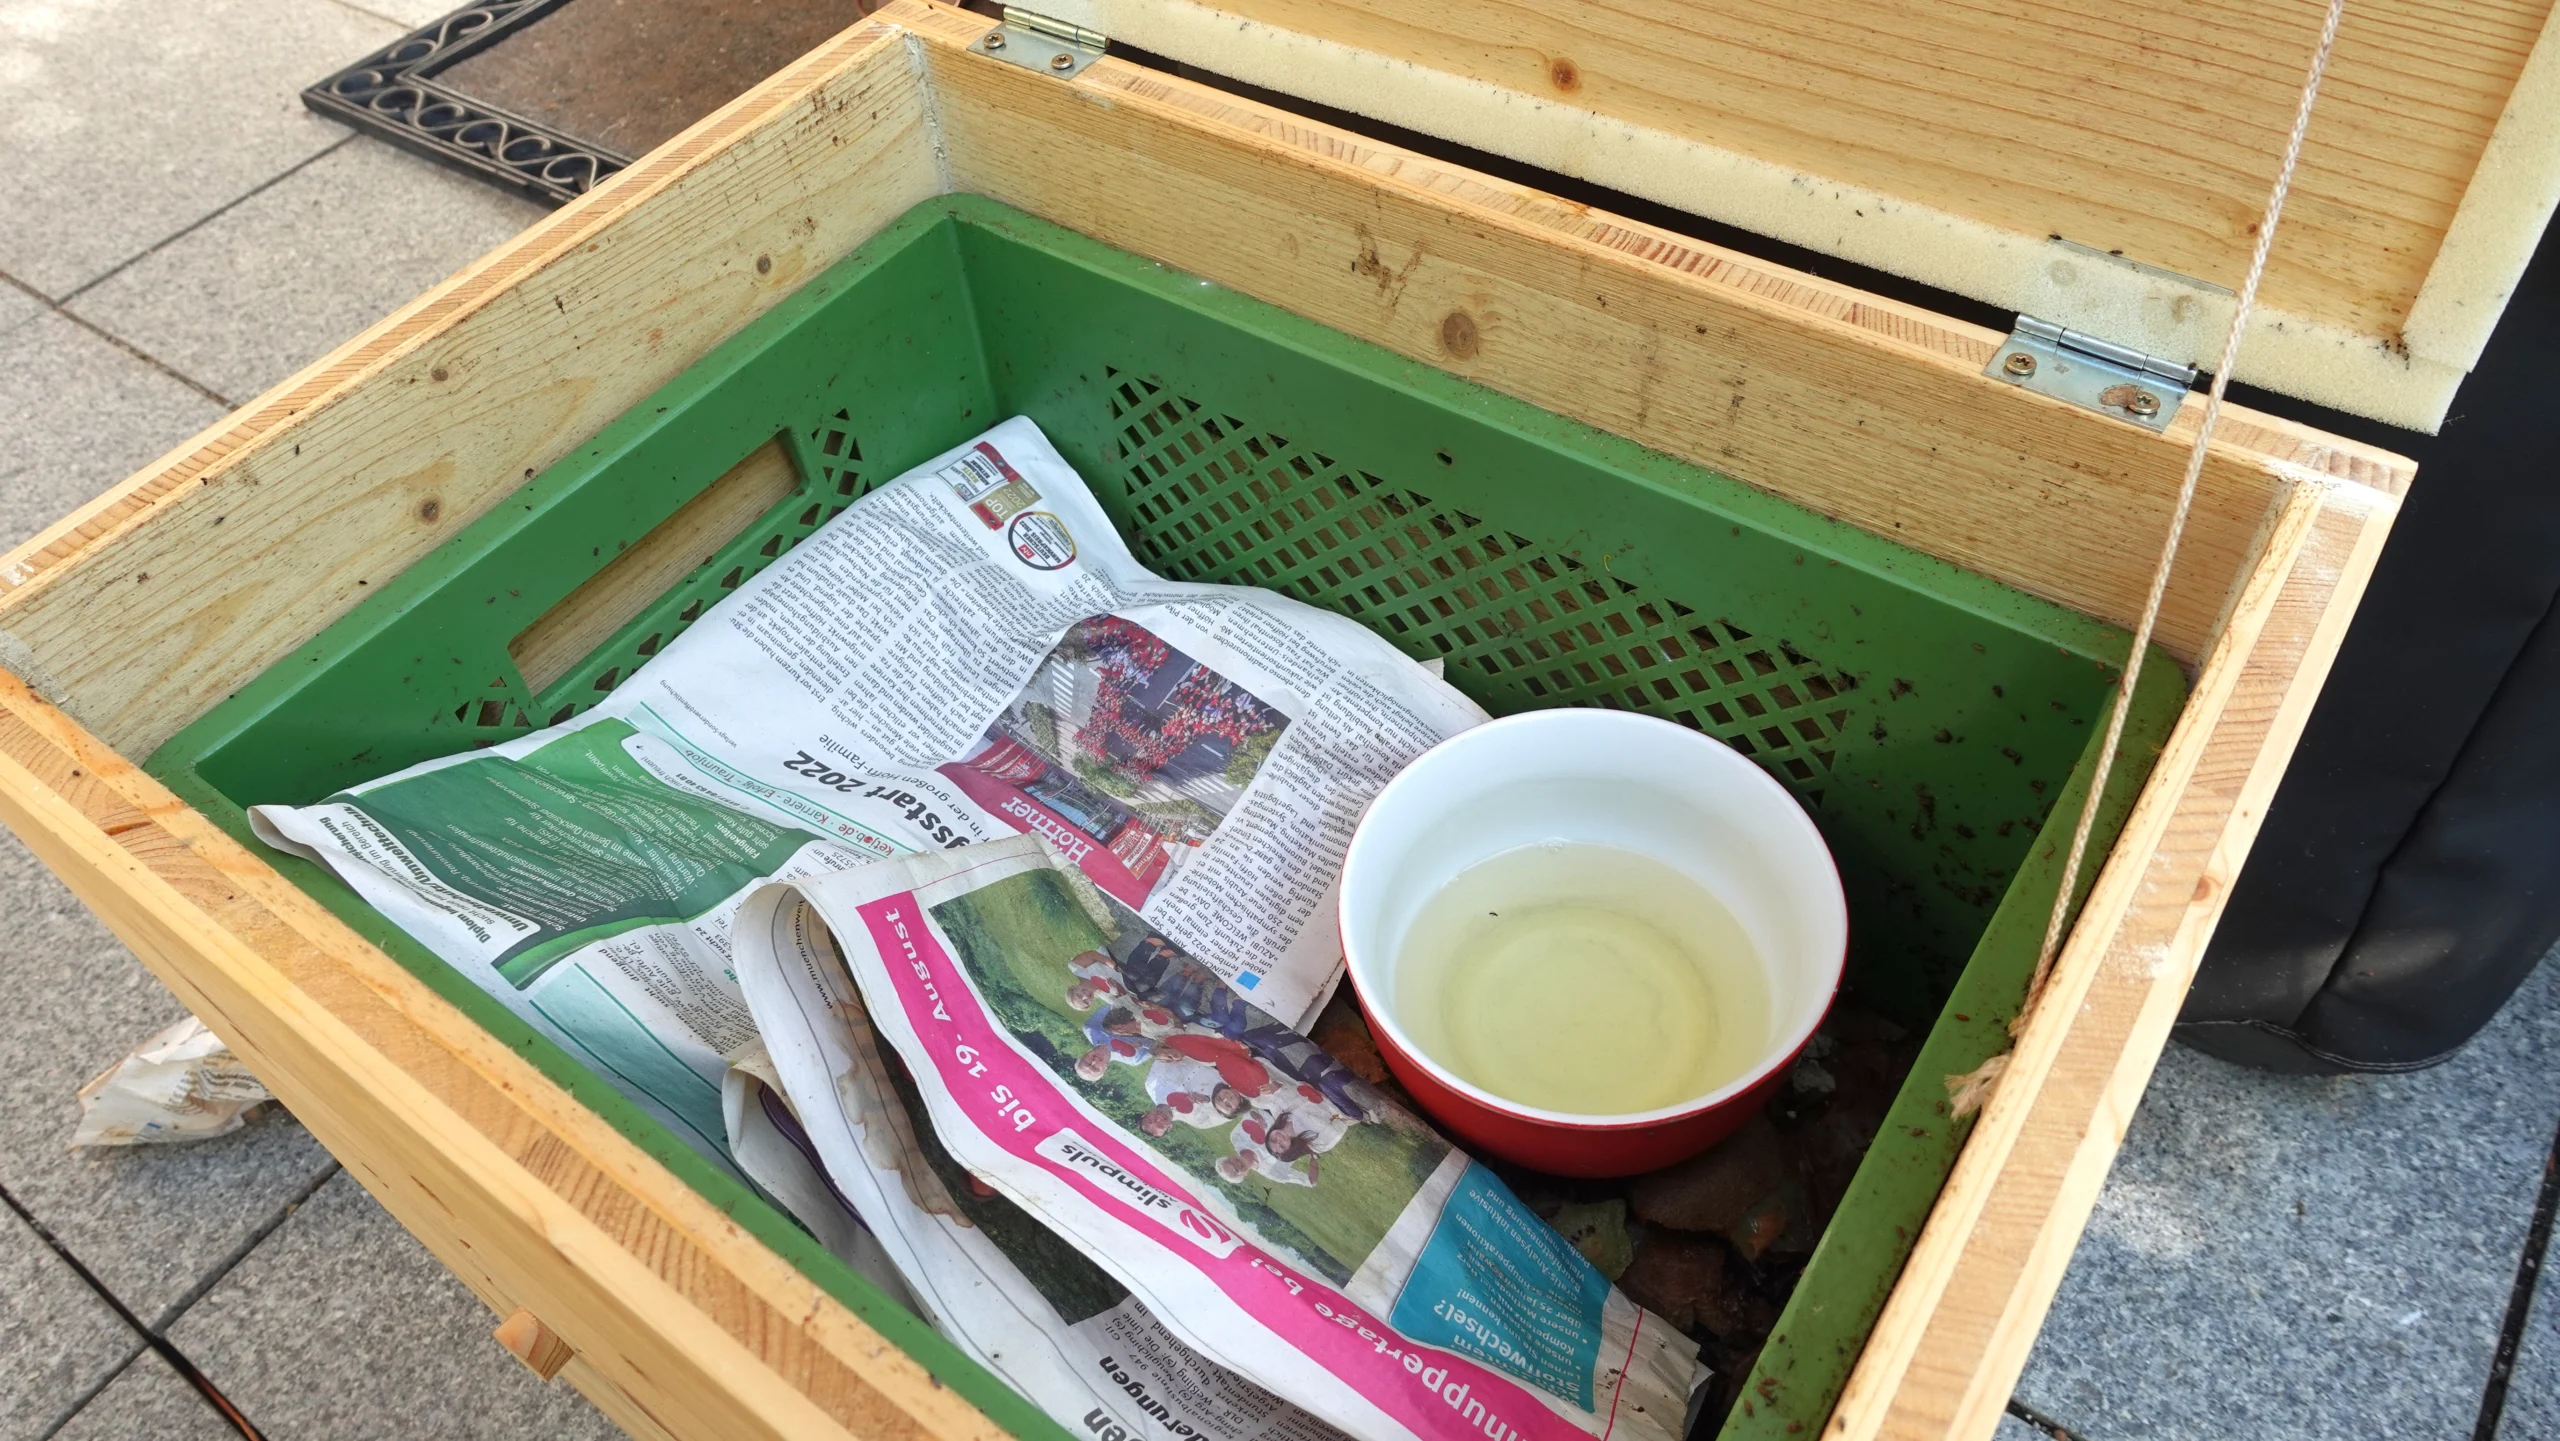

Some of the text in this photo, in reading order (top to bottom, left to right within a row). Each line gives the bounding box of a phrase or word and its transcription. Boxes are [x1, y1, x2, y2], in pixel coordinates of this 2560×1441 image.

[984, 496, 1008, 518] TOP
[1002, 486, 1024, 507] 2022
[1019, 519, 1031, 532] 2022
[1020, 546, 1032, 556] ntv
[1022, 531, 1050, 559] DEUTSCHER
[1031, 531, 1061, 563] SERVICEPREIS
[745, 616, 756, 625] in
[754, 622, 798, 661] gemeinsam
[726, 615, 826, 703] Erst vor kurzem haben die Stu-
[795, 658, 835, 695] dierenden,
[837, 696, 848, 706] ar-
[848, 706, 864, 720] hier
[828, 702, 895, 760] besonders wichtig.
[870, 723, 881, 733] an
[880, 732, 896, 746] gut
[683, 747, 734, 782] Traumjob
[782, 748, 866, 793] 2022
[817, 733, 982, 837] in der großen Höffi-Familie
[503, 815, 517, 826] für
[528, 810, 541, 819] für
[782, 795, 828, 824] Karriere
[341, 819, 371, 851] Bereich
[539, 807, 622, 853] im Bereich Quecksilber
[712, 821, 760, 859] Fähigkeiten:
[735, 822, 769, 850] sehr gute
[369, 849, 380, 861] im
[644, 845, 685, 894] Projektleiter
[666, 849, 696, 884] Wartung
[1175, 884, 1188, 895] be-
[1191, 892, 1211, 909] DAY«
[456, 912, 489, 944] Diplom
[715, 915, 728, 929] Tel.
[1146, 912, 1165, 930] Sep-
[1168, 889, 1272, 969] um die Zukunft: Zum großen
[1211, 909, 1248, 942] WELCOME
[630, 939, 643, 954] Tel.
[695, 926, 726, 955] sucht 24
[1153, 905, 1239, 973] tember 2022 geht es bei
[1161, 897, 1267, 977] Möbel Höffner einmal mehr
[598, 947, 639, 982] dringend
[882, 906, 952, 1020] August
[643, 986, 668, 1008] sucht
[655, 976, 675, 996] gute
[954, 1032, 989, 1079] 19.
[986, 1081, 1037, 1132] bis
[1060, 1141, 1171, 1212] slimpuls
[1467, 1188, 1509, 1231] inklusive
[1485, 1188, 1505, 1208] und
[1504, 1205, 1582, 1292] Bauchfettmessung
[1250, 1256, 1303, 1295] bei
[1455, 1287, 1502, 1324] kennen!
[1537, 1300, 1553, 1313] 25
[1555, 1310, 1582, 1329] über
[1102, 1321, 1120, 1341] Gil-
[1111, 1316, 1125, 1330] (S)
[1121, 1311, 1144, 1334] Linie
[1538, 1315, 1579, 1339] unsere
[1121, 1329, 1174, 1382] Neugilching
[1143, 1334, 1160, 1352] Die
[1521, 1340, 1539, 1358] Sie
[1533, 1338, 1572, 1366] unsere
[1128, 1351, 1148, 1371] 947
[1133, 1301, 1260, 1422] verkehrt durchgehend im
[1175, 1366, 1213, 1405] Weßling
[1177, 1387, 1192, 1401] (S)
[1211, 1367, 1267, 1418] Stundentakt
[1150, 1370, 1234, 1440] Regionalbuslinie
[1193, 1399, 1242, 1434] ching-Arg.
[1222, 1408, 1244, 1424] DLR
